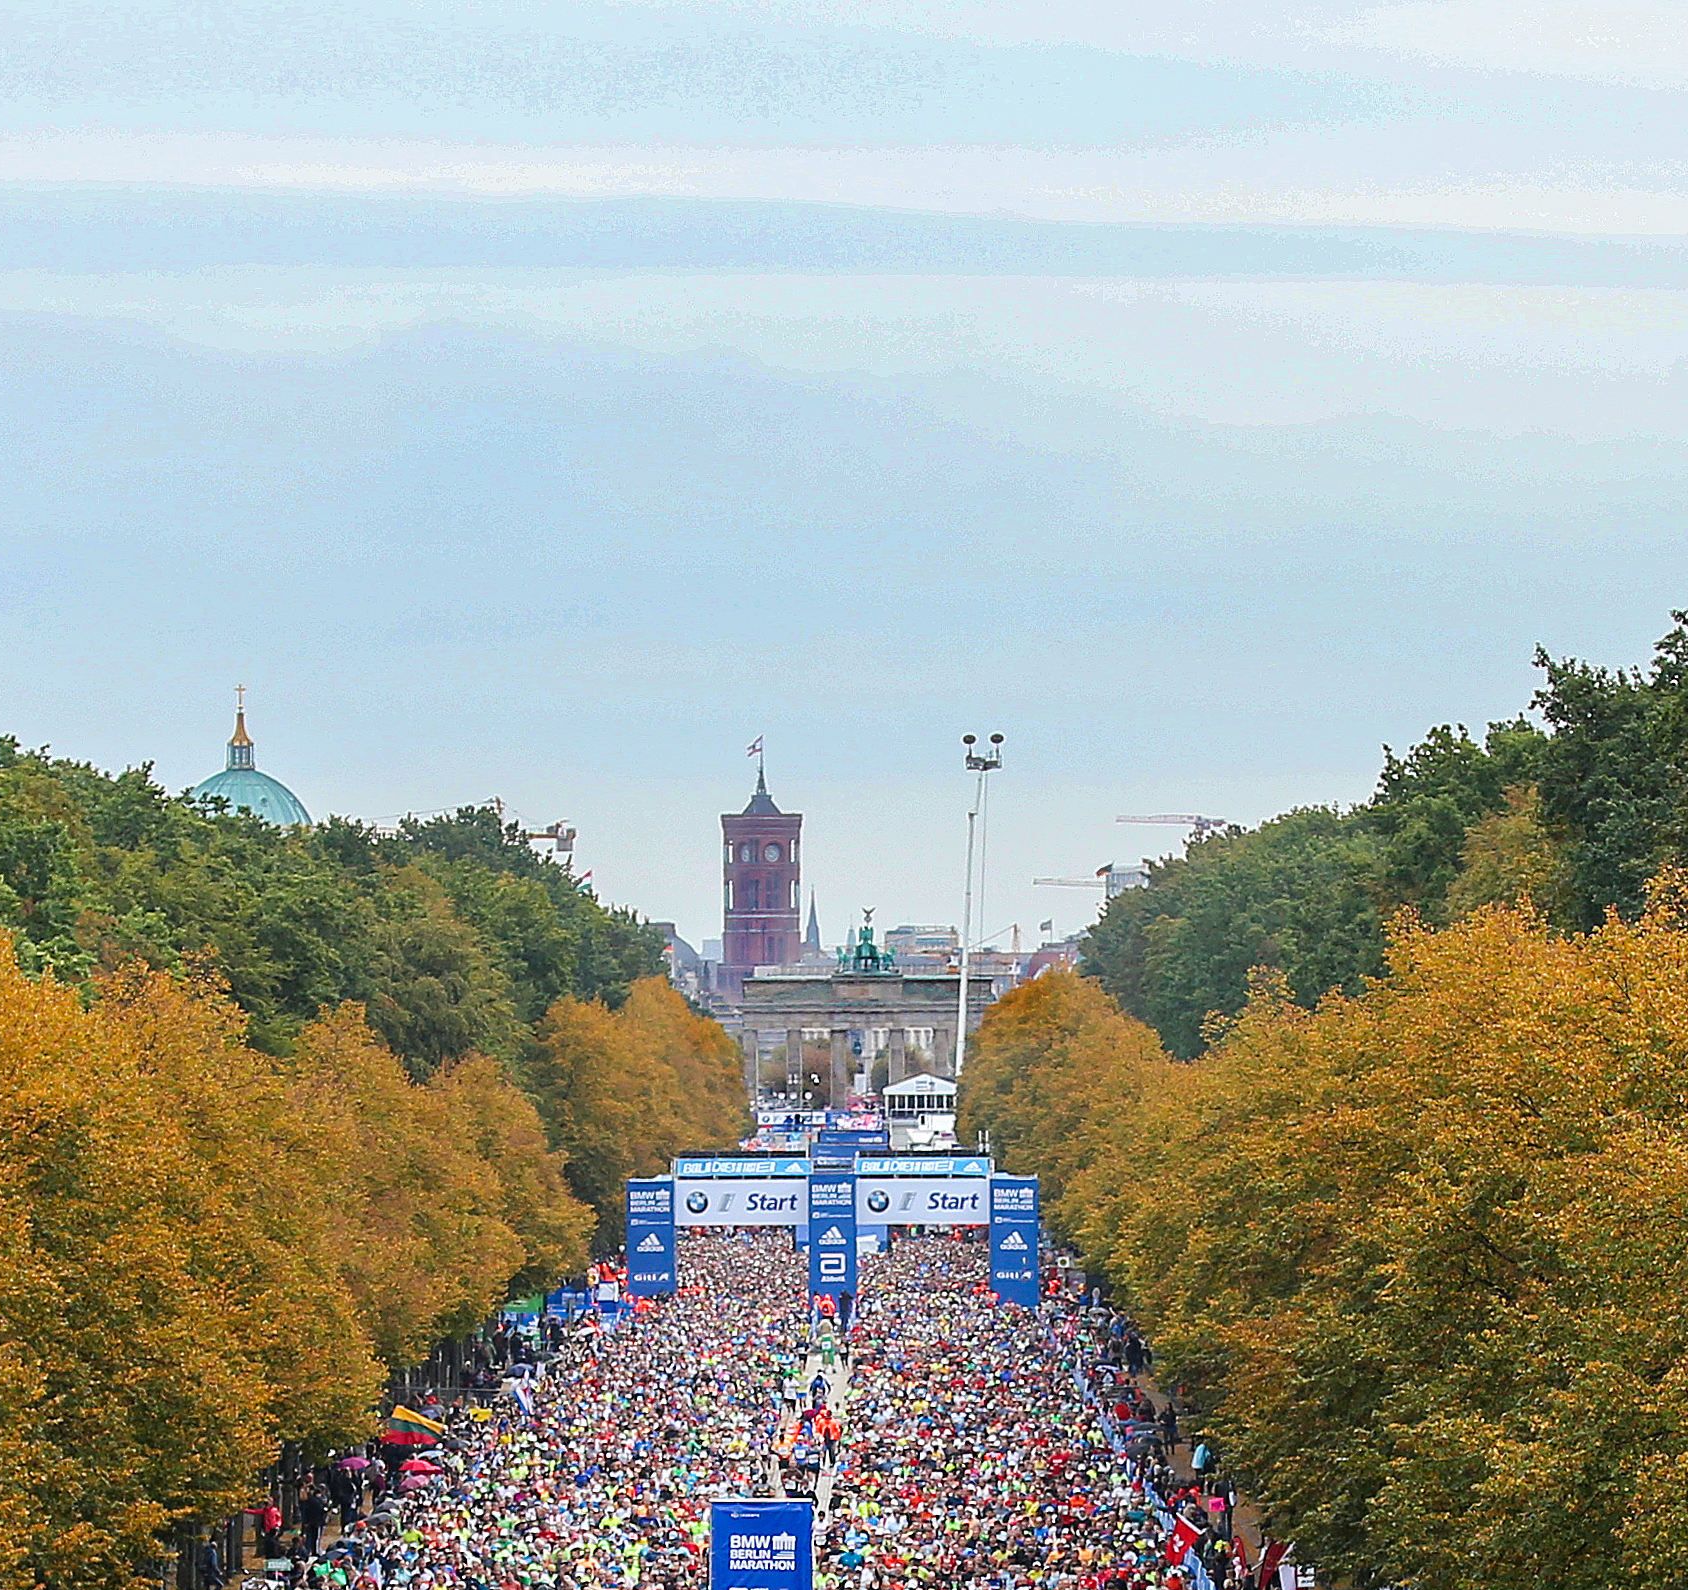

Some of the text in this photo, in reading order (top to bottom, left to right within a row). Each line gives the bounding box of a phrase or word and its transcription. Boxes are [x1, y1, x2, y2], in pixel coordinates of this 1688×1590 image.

[812, 1184, 837, 1193] BMW
[993, 1188, 1019, 1197] BMW
[630, 1191, 655, 1200] BMW
[746, 1193, 798, 1211] Start
[927, 1192, 979, 1210] Start
[730, 1535, 771, 1548] BMW
[730, 1549, 771, 1559] BERLIN
[730, 1560, 795, 1570] MARATHON
